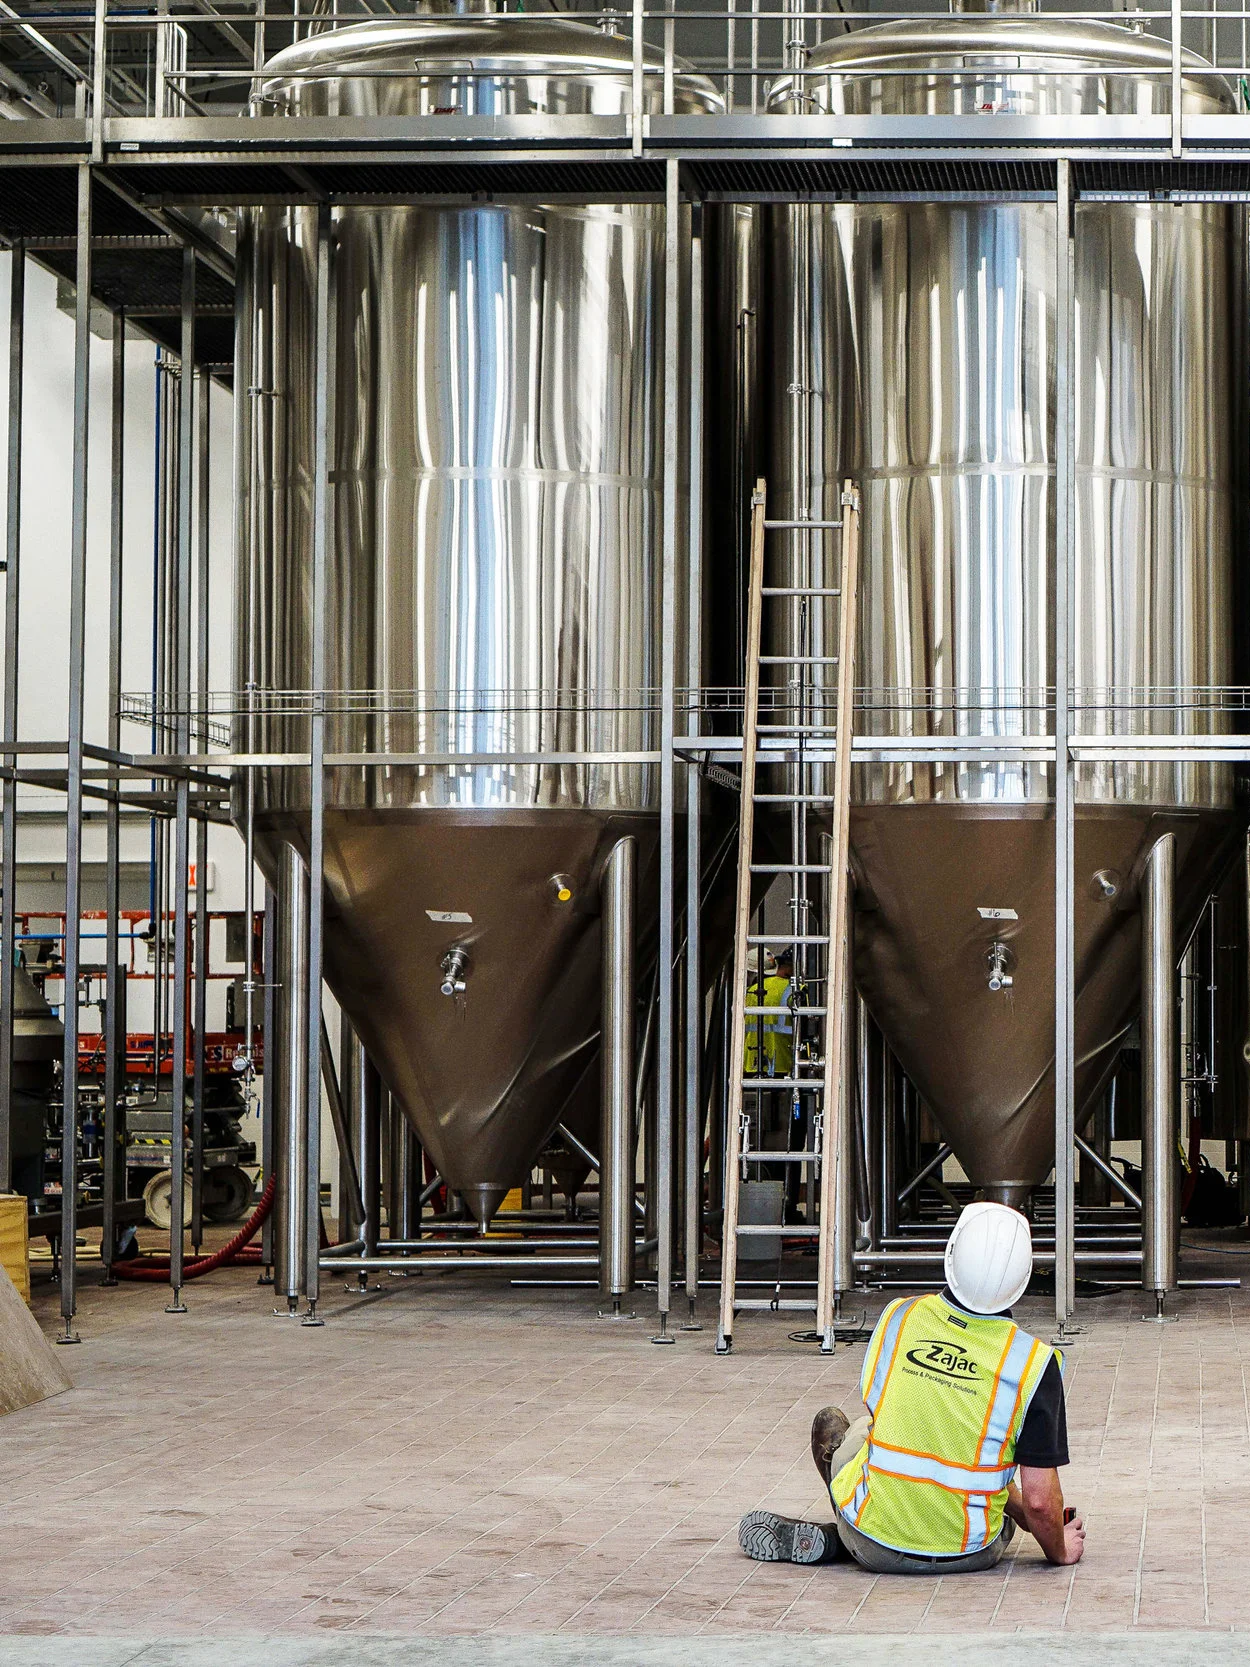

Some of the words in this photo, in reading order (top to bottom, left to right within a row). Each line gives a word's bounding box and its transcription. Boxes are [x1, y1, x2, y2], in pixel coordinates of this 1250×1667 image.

[926, 1345, 978, 1374] Zajac
[925, 1373, 952, 1387] Packaging
[953, 1382, 977, 1396] Solutions
